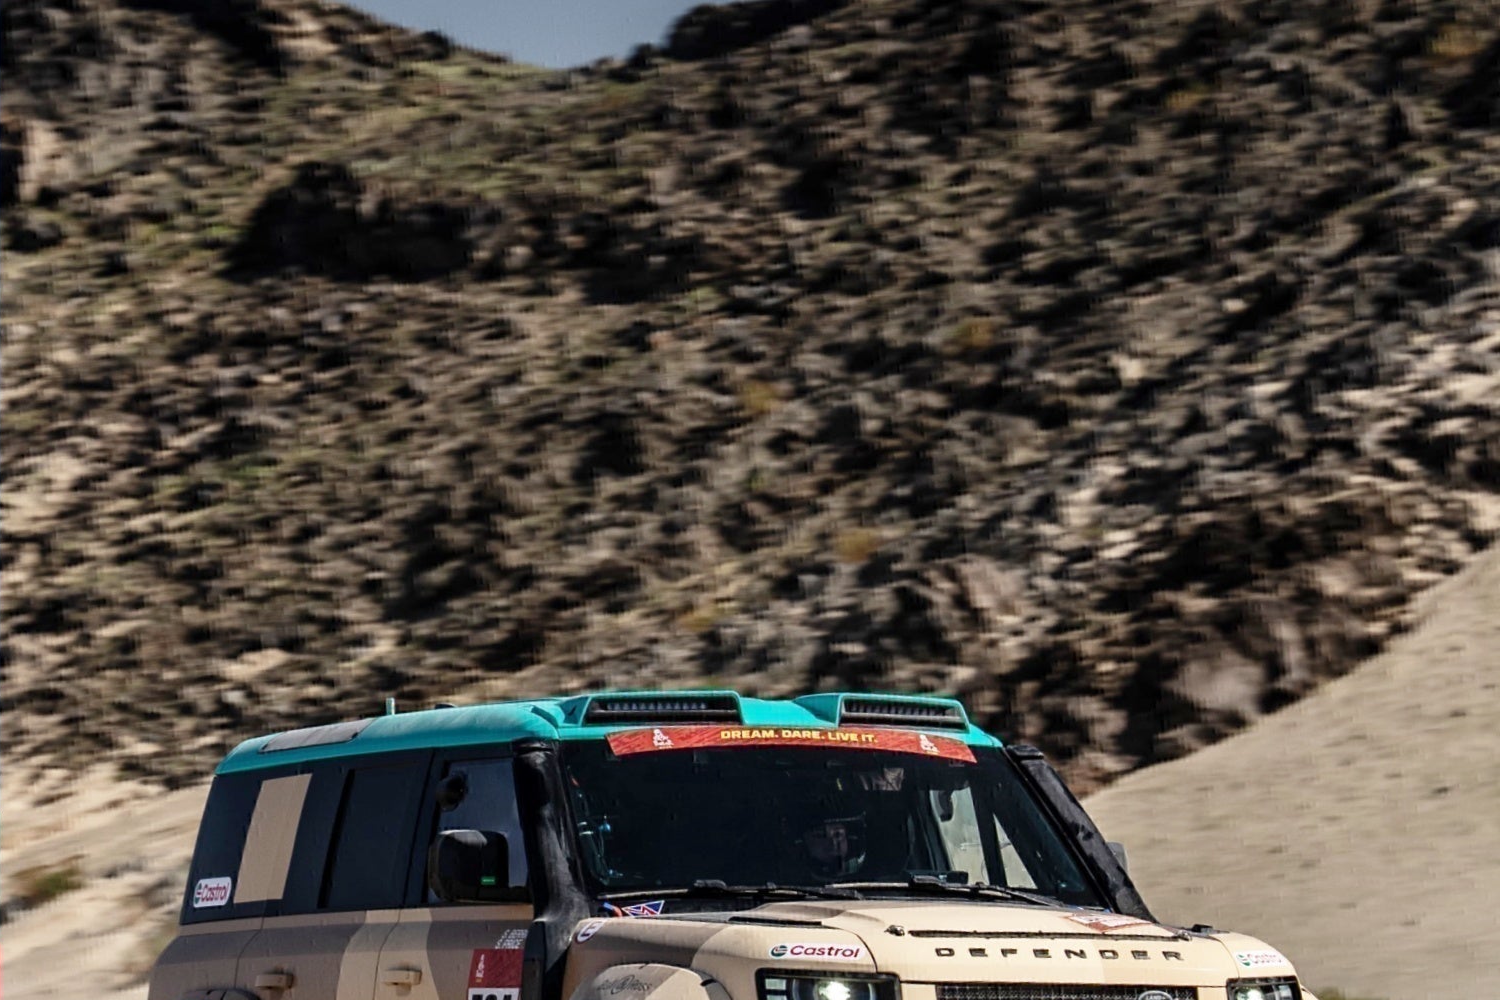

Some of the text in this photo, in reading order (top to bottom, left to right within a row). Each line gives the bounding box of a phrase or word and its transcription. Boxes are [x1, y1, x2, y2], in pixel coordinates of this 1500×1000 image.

[720, 729, 878, 743] DREAM. DARE. LIVE IT.
[201, 882, 230, 902] Castrol
[790, 945, 860, 958] Castrol
[935, 947, 1185, 961] DEFENDER
